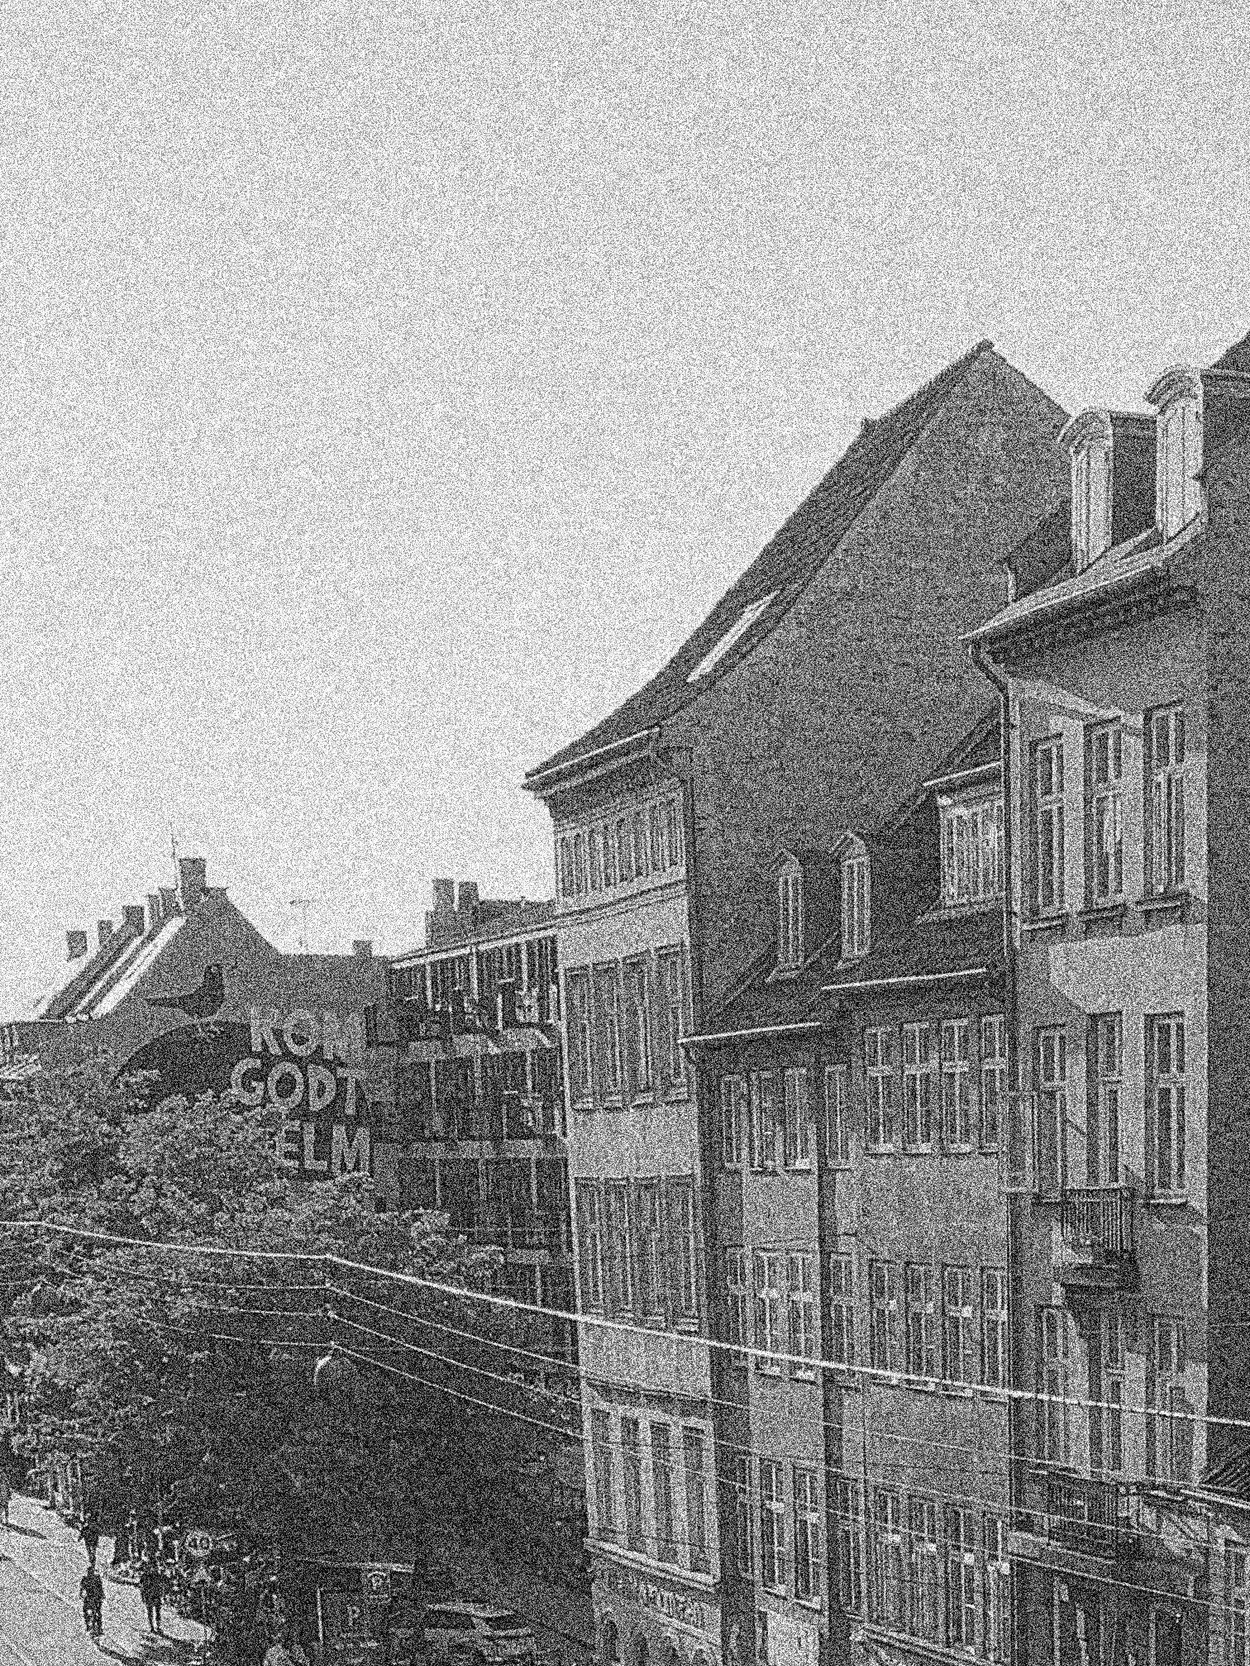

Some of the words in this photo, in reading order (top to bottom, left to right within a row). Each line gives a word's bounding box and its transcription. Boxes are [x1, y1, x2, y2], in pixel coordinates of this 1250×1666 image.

[251, 1005, 366, 1061] KOM
[231, 1058, 367, 1115] GODT
[188, 1536, 209, 1550] 40
